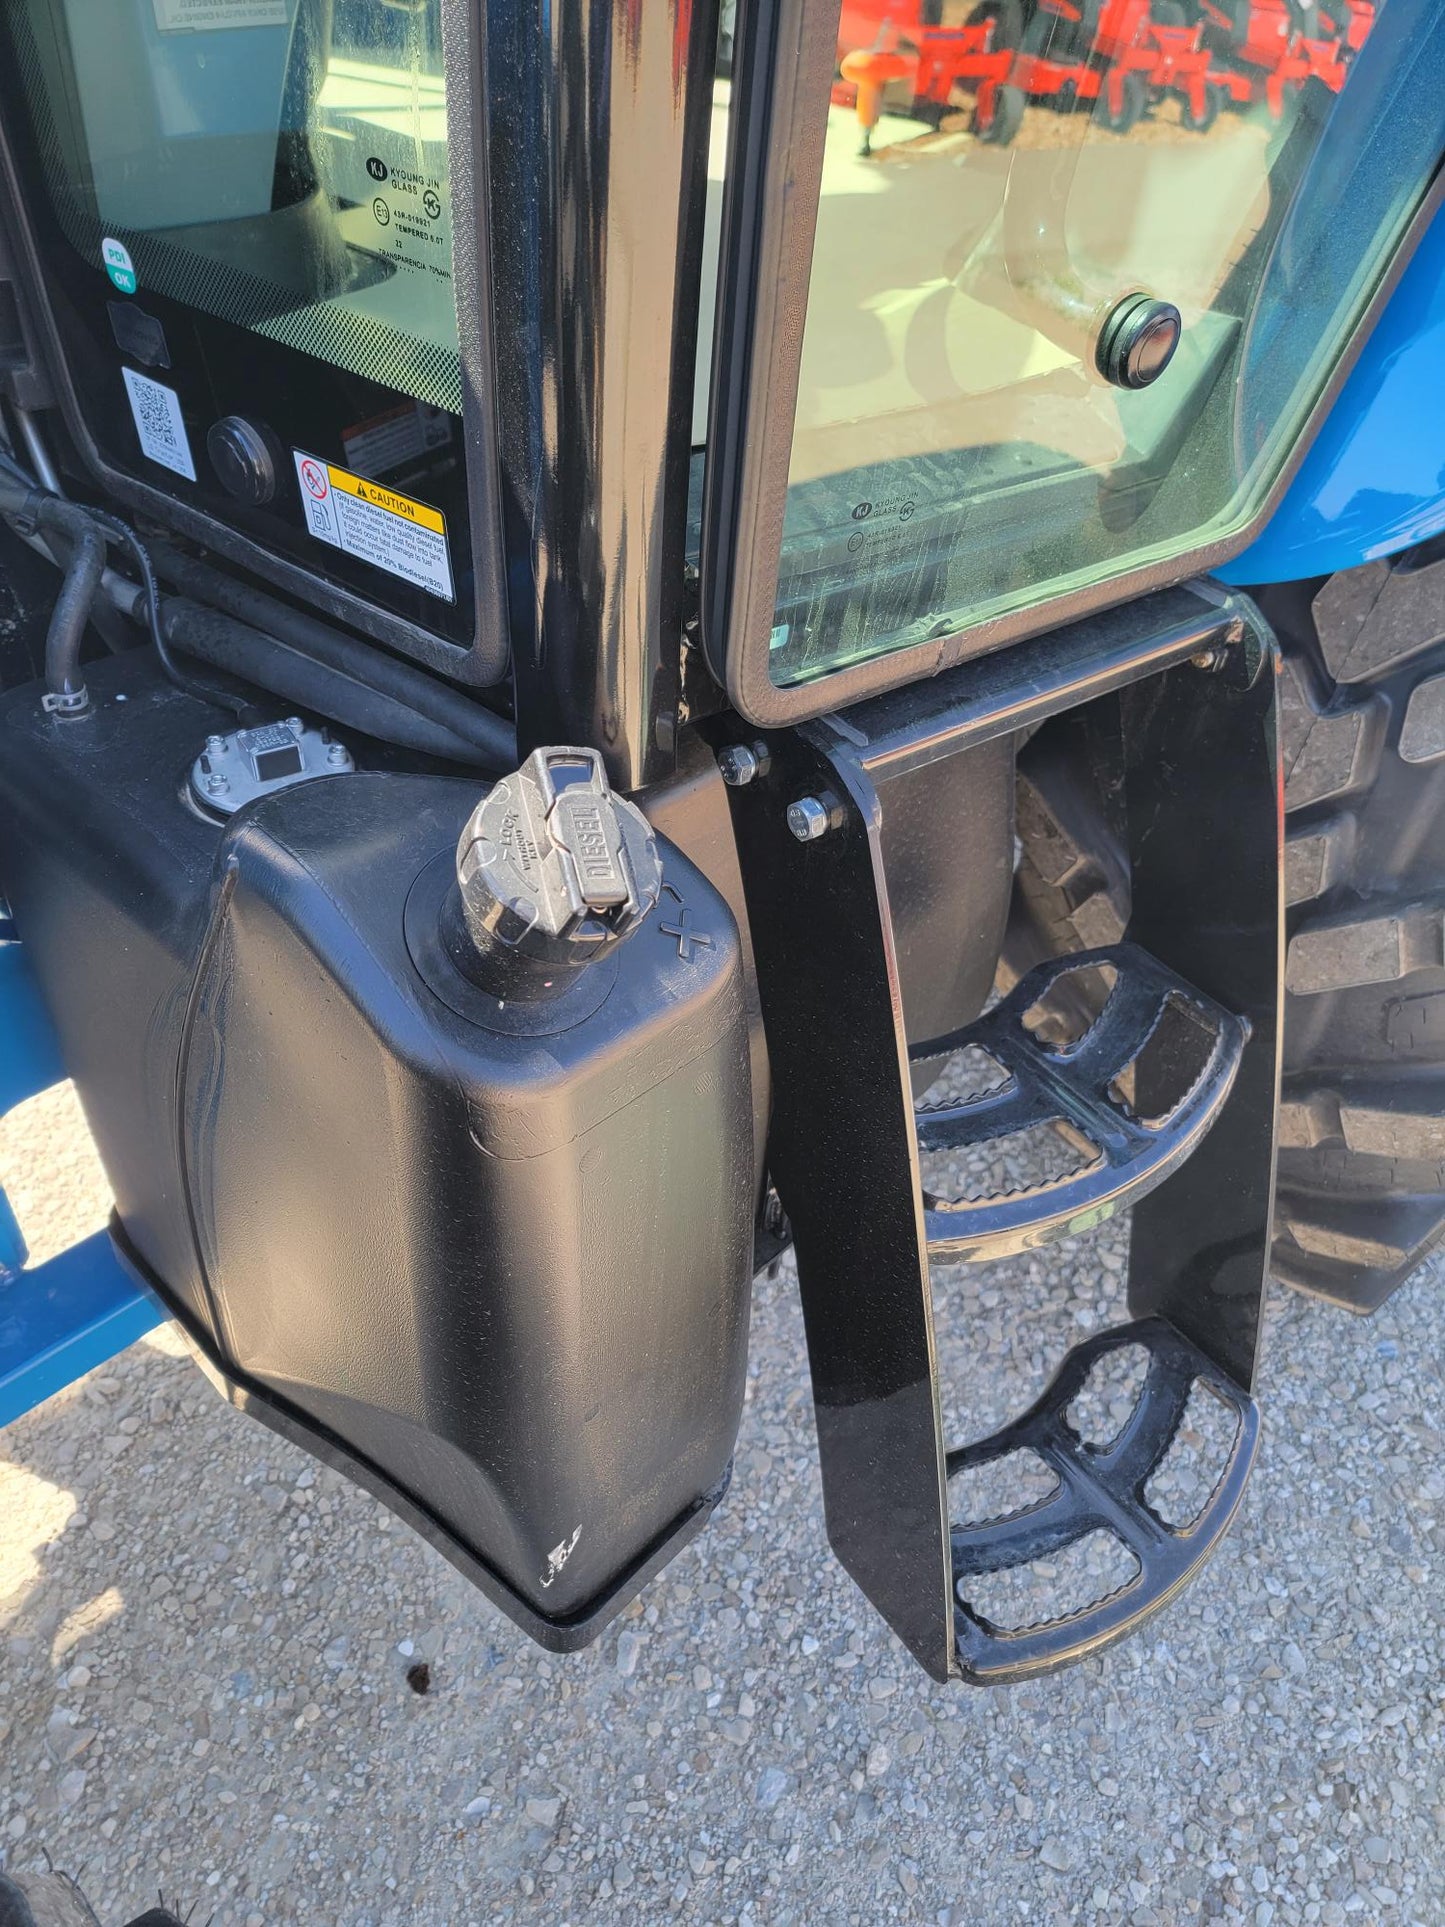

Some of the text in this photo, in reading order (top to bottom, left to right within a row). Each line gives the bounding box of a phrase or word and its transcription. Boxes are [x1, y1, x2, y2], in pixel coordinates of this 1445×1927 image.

[390, 167, 440, 190] KYOUNG JIN
[391, 179, 418, 195] GLASS
[395, 223, 429, 241] TEMPERED
[108, 248, 126, 264] PDI
[378, 248, 427, 270] TRANSPARENCIA
[114, 272, 132, 289] OK
[370, 489, 415, 517] CAUTION
[873, 506, 897, 517] GLASS
[500, 808, 519, 846] LOCK
[570, 807, 616, 880] DIESEL
